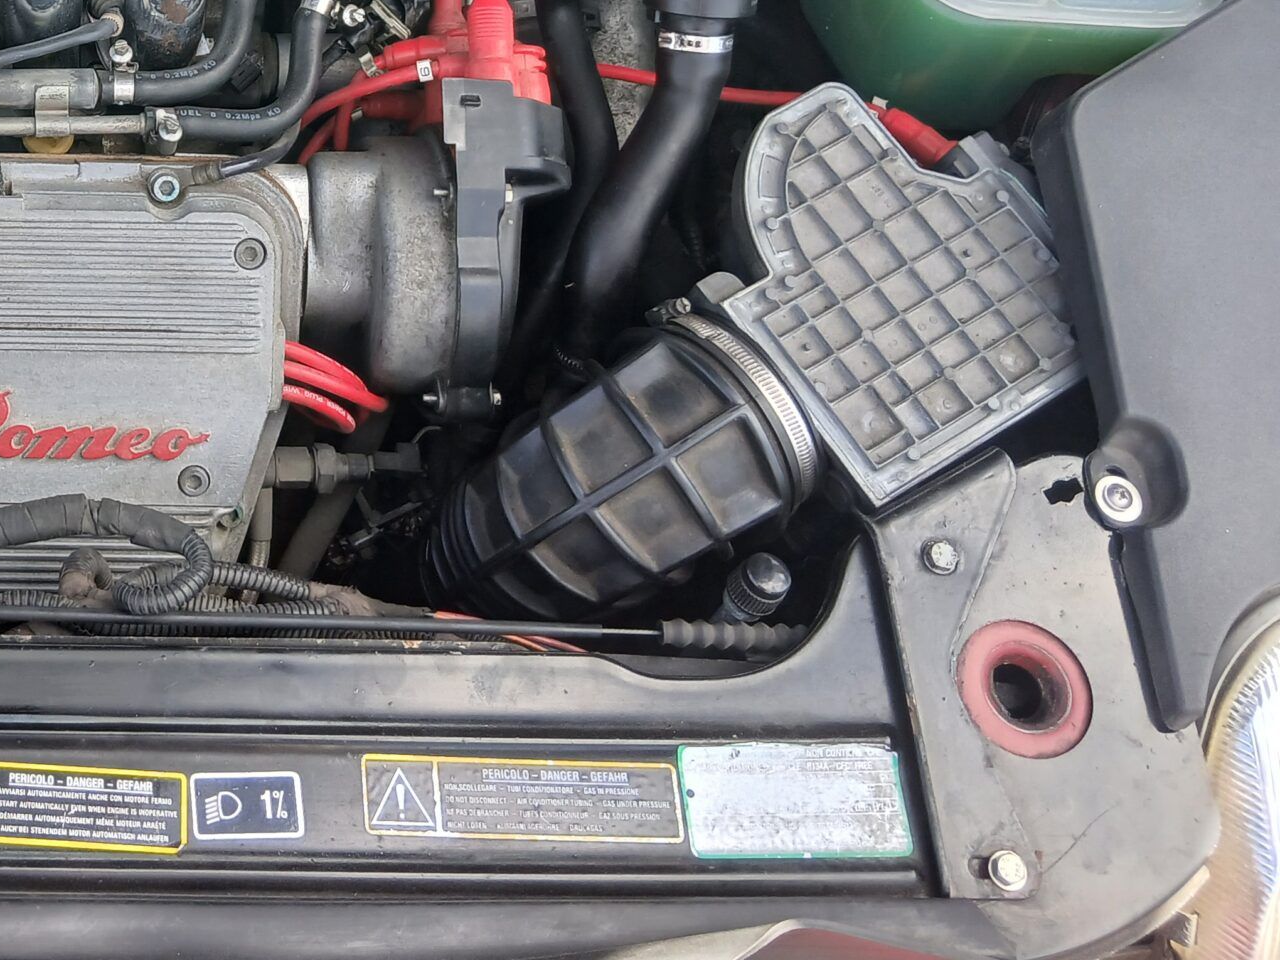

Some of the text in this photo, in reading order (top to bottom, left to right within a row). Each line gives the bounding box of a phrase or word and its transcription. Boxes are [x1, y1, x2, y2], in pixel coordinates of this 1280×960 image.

[9, 772, 153, 792] PERICOLO DANGER GEFAHR
[482, 768, 628, 783] PERICOLO DANGER GEFAHR
[27, 789, 86, 800] AUTOMATICAMENTE
[87, 793, 108, 801] ANCHE
[124, 795, 149, 804] MOTORE
[150, 797, 172, 805] FERMO
[260, 789, 289, 819] 1%
[20, 801, 69, 811] AUTOMATICALLY
[87, 805, 106, 814] WHEN
[107, 806, 129, 815] ENGINE
[139, 809, 178, 818] INOPERATIVE
[0, 824, 17, 832] AUCH
[68, 828, 91, 837] MOTOR
[92, 831, 136, 840] AUTOMATISCH
[136, 834, 169, 842] ANLAUFEN
